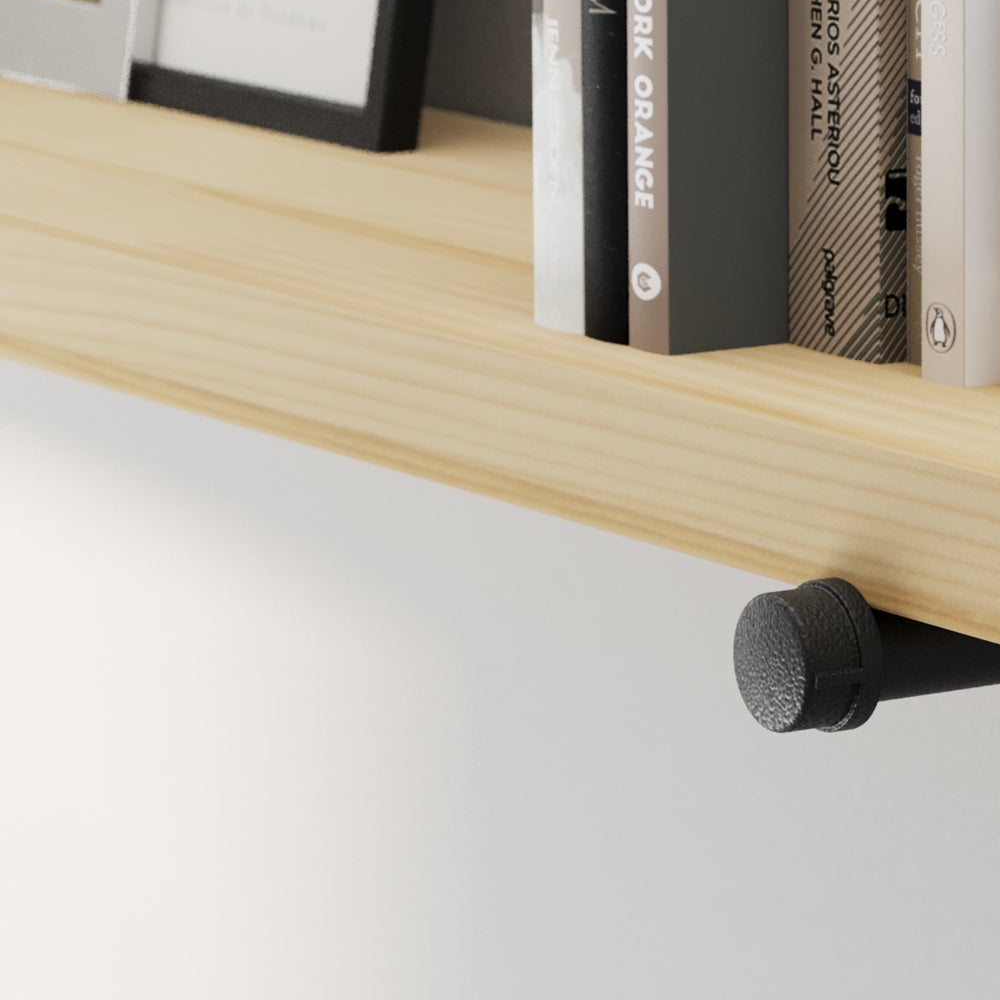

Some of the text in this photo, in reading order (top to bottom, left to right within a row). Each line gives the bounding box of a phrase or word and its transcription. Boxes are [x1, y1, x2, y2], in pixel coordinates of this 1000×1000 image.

[810, 46, 823, 72] G.
[634, 73, 655, 210] ORANGE
[810, 78, 823, 141] HALL
[826, 63, 842, 186] ASTERIOU
[820, 247, 838, 337] palgrave
